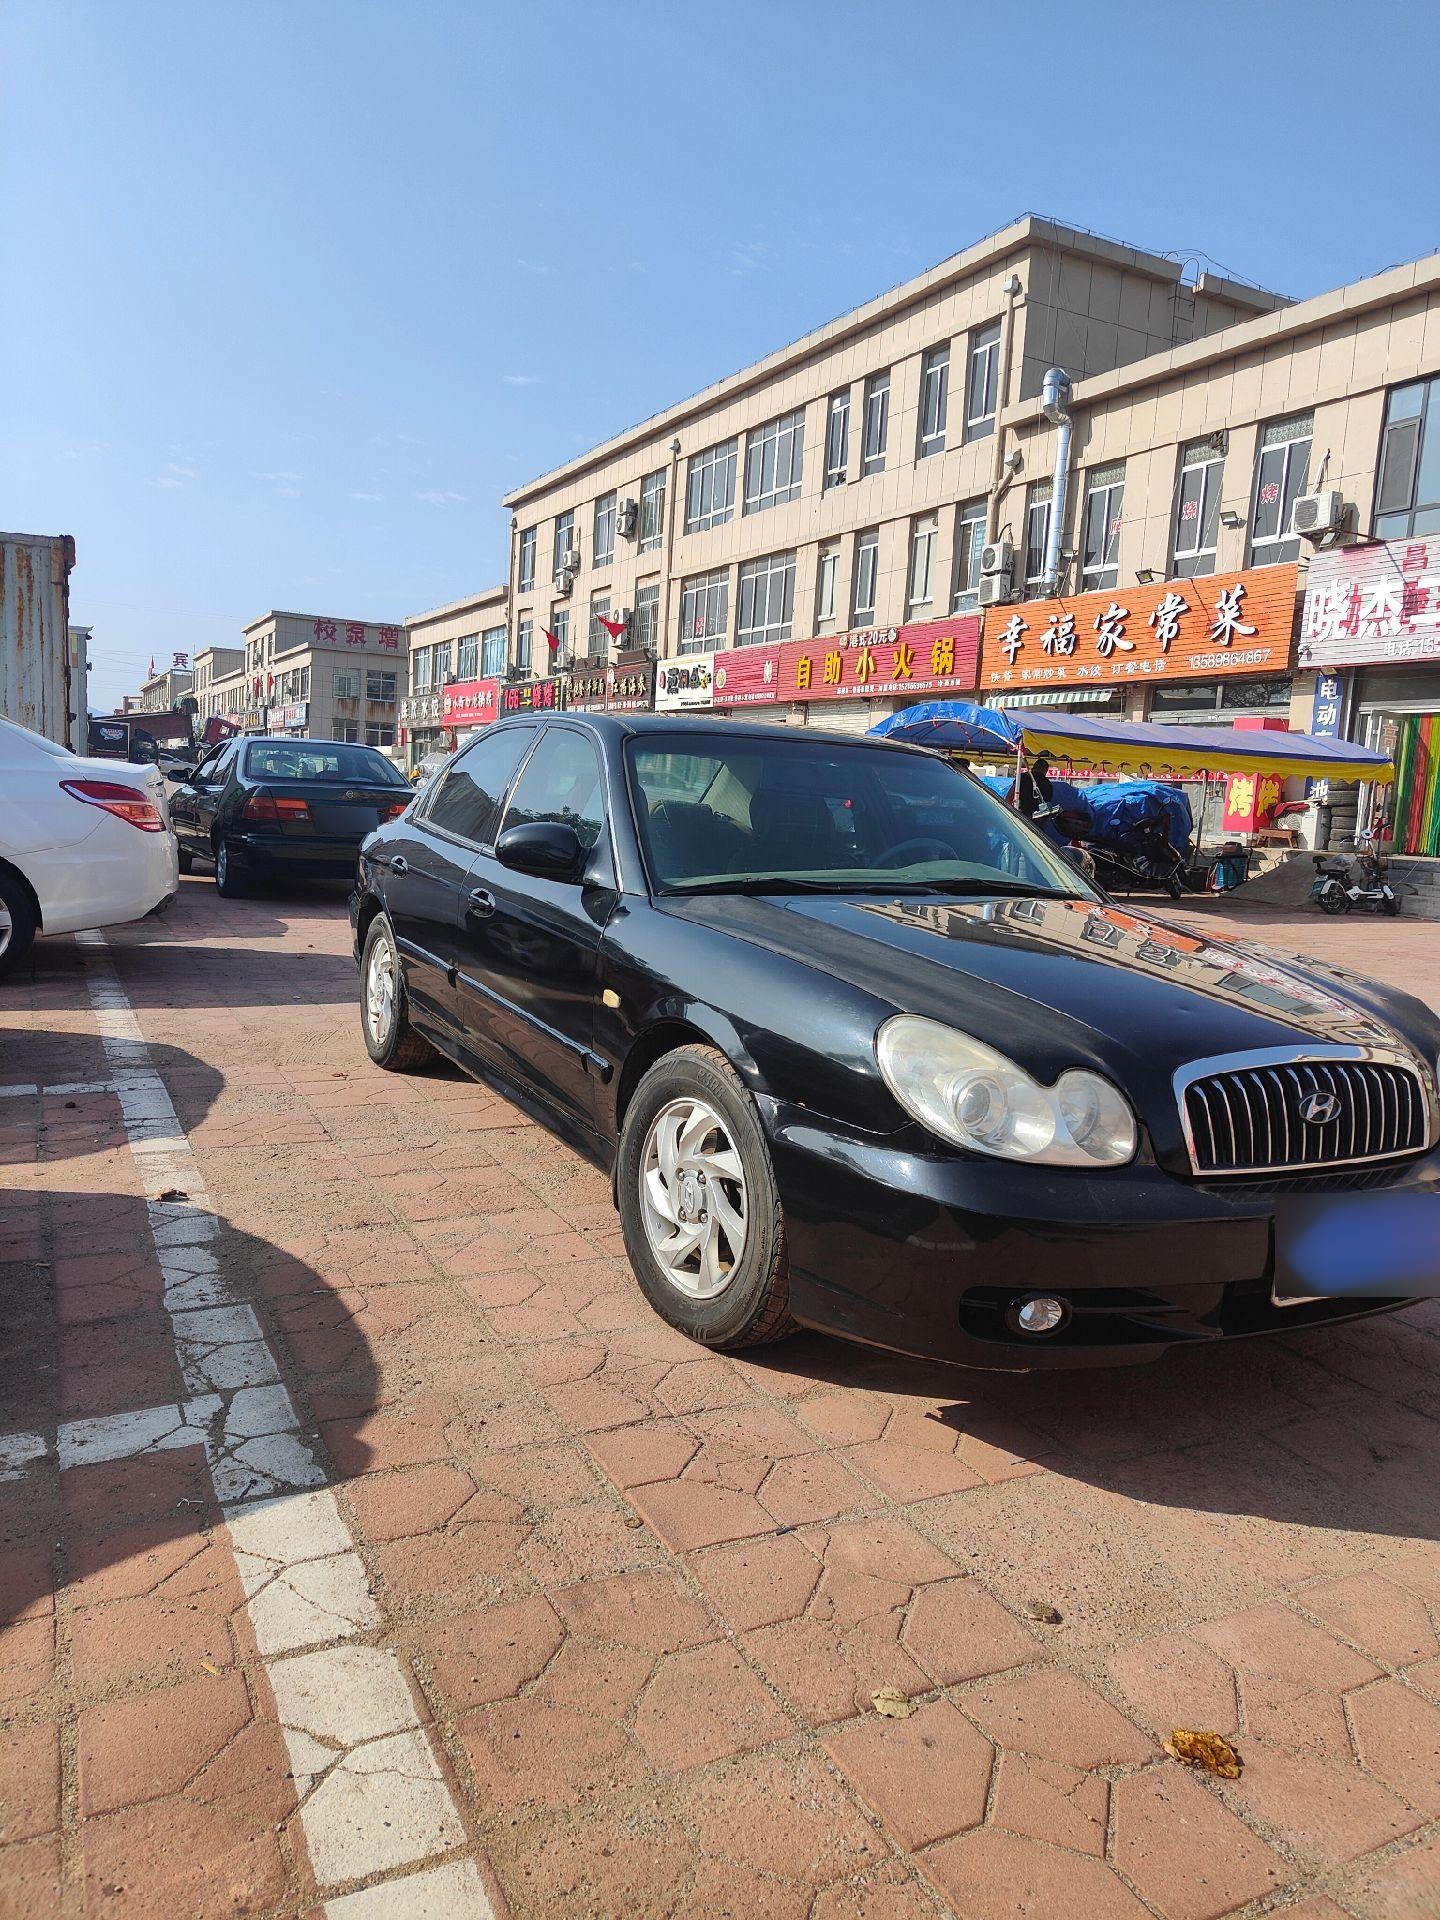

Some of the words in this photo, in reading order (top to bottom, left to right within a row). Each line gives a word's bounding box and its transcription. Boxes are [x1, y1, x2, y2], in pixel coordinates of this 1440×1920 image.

[997, 583, 1257, 665] 幸福家常菜
[172, 652, 189, 669] 宾
[796, 636, 956, 689] 自助小火锅
[1111, 658, 1168, 675] 订餐电话
[1188, 647, 1272, 669] 13589864867
